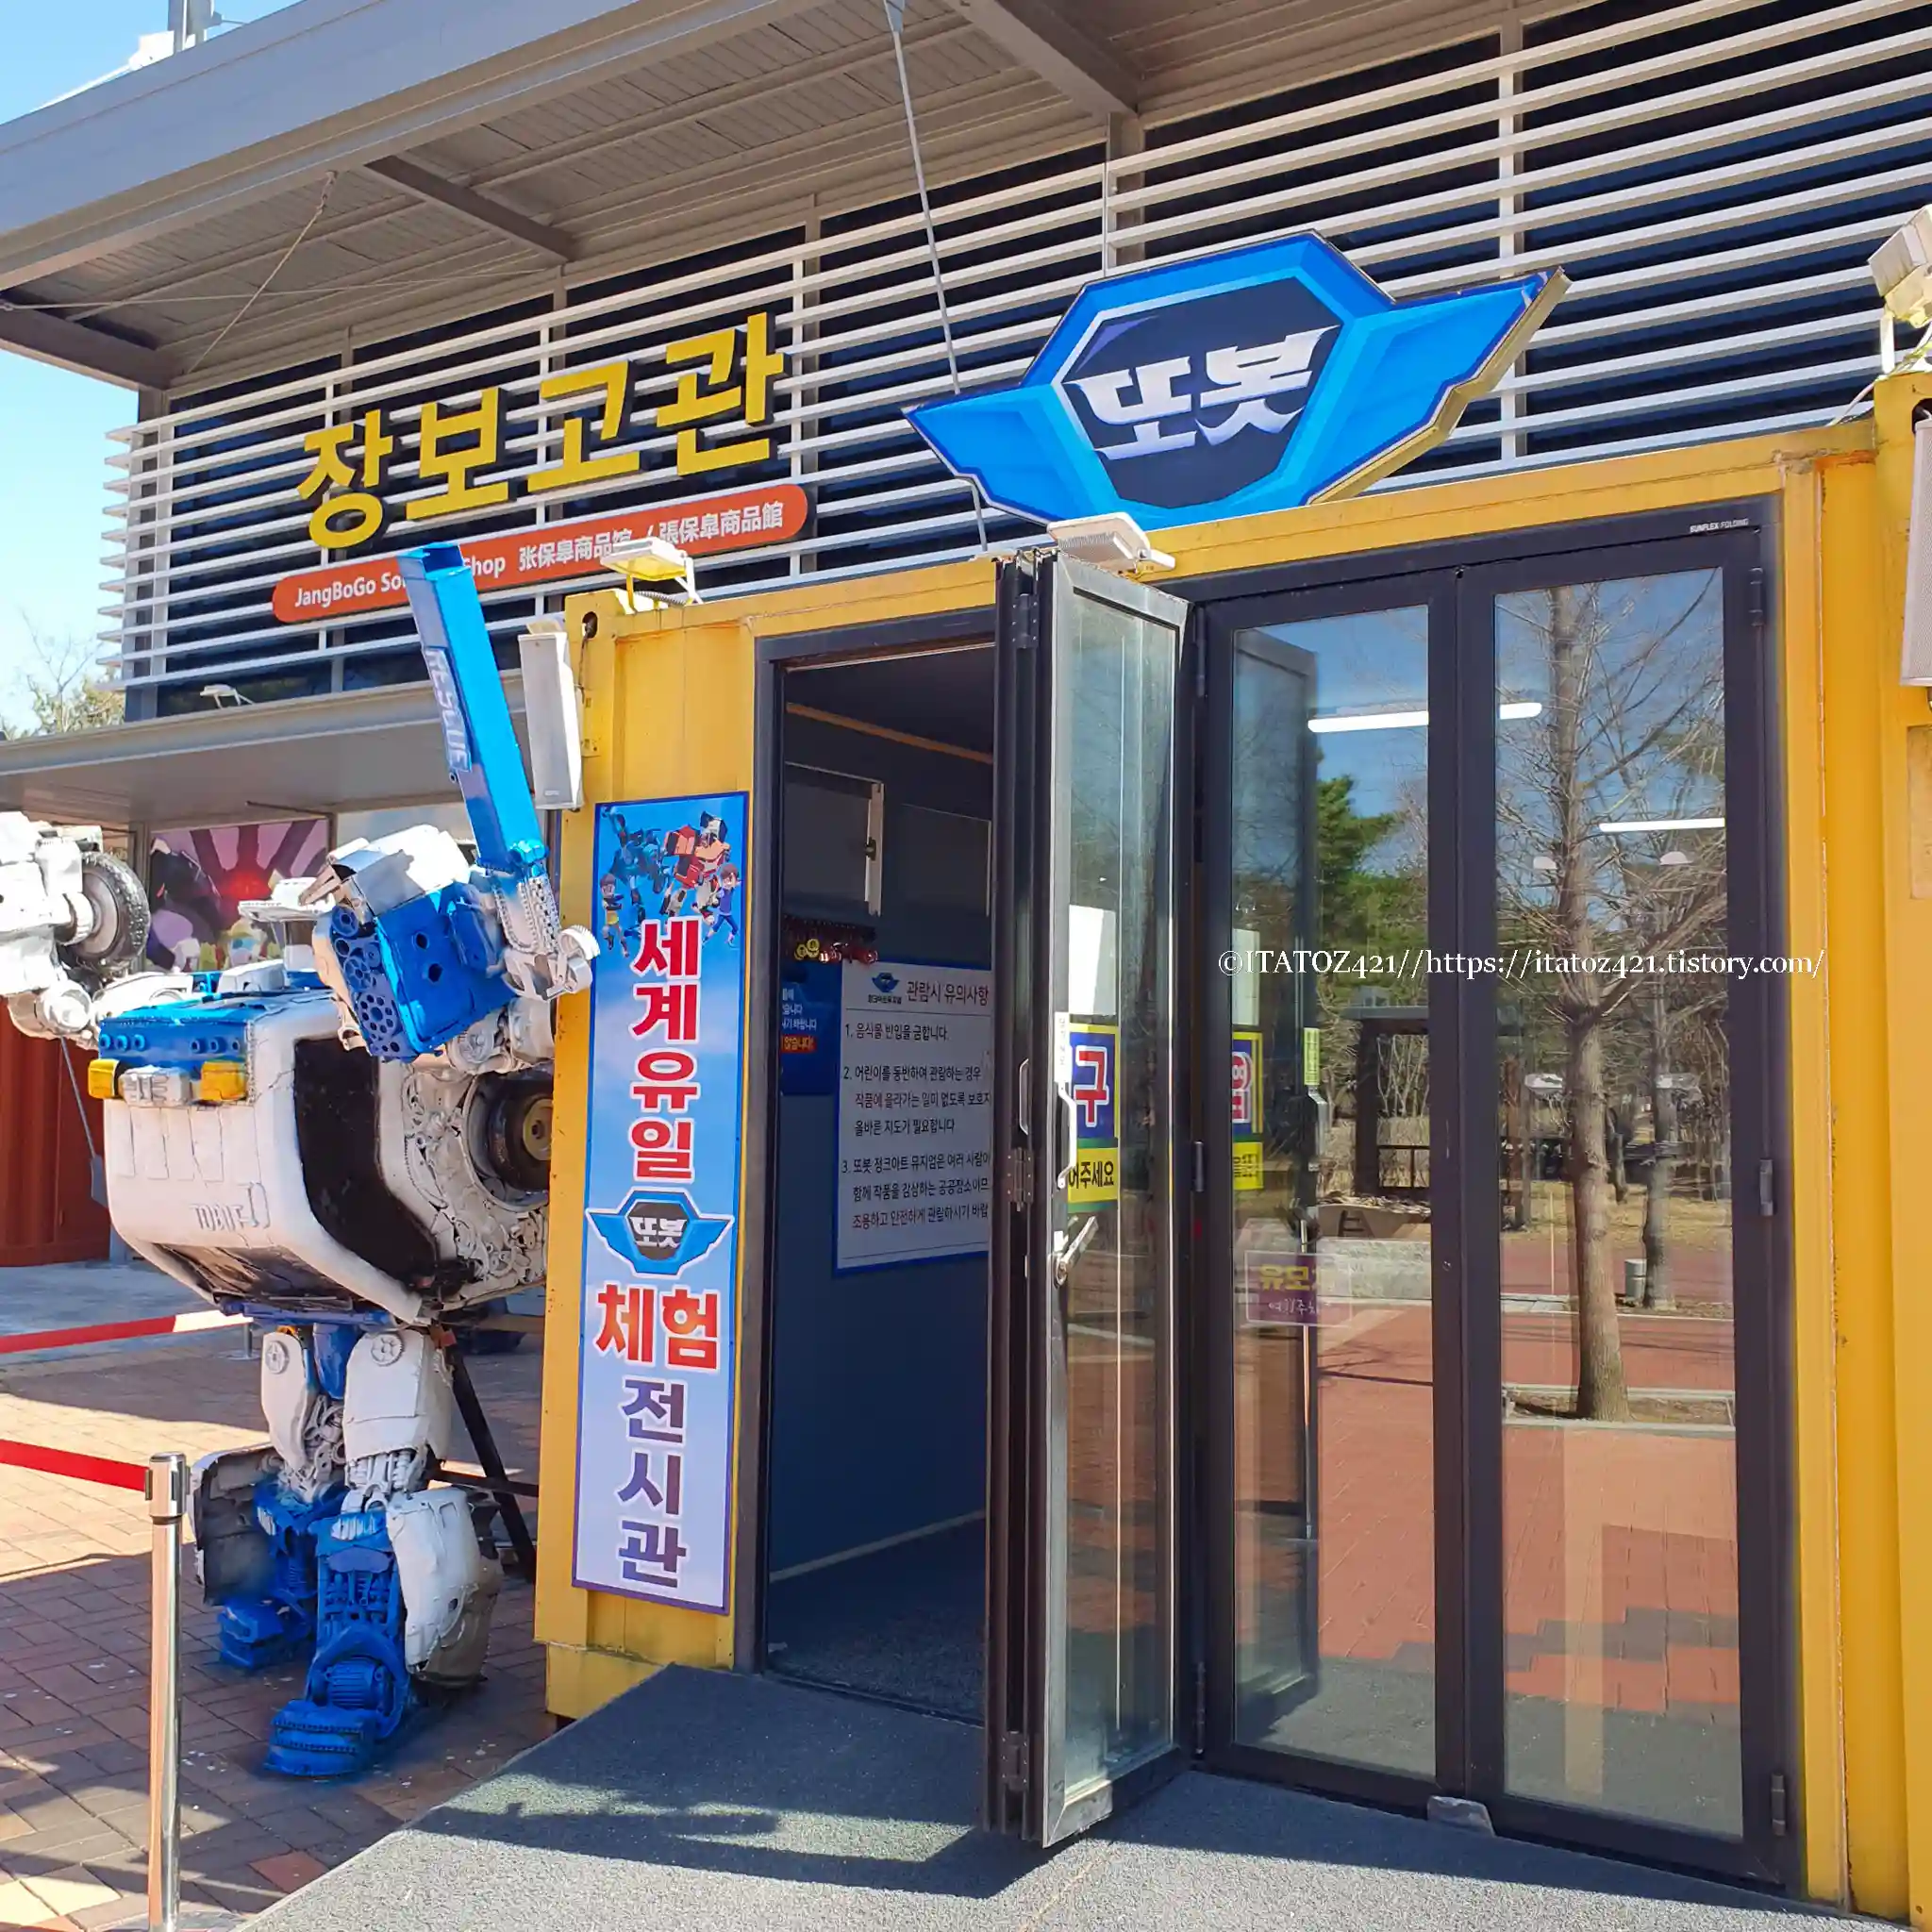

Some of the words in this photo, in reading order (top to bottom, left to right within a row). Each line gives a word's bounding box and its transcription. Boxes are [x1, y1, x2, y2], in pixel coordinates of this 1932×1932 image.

[1061, 325, 1341, 461] 또봇
[296, 311, 787, 548] 장보고관
[294, 575, 376, 608] JangBoGo
[907, 981, 941, 1003] 관람시
[944, 983, 989, 1007] 유의사항
[845, 1024, 853, 1038] 1.
[856, 1023, 883, 1040] 음식물
[630, 918, 702, 1181] 세계유일
[843, 1066, 853, 1080] 2.
[855, 1065, 891, 1082] 어린이를
[892, 1065, 927, 1082] 동반하여
[929, 1065, 963, 1082] 관람하는
[965, 1067, 982, 1082] 경우
[855, 1092, 883, 1109] 작품에
[885, 1091, 920, 1109] 올라가는
[941, 1092, 966, 1108] 없도록
[854, 1120, 882, 1137] 올바른
[884, 1119, 910, 1135] 지도가
[841, 1160, 851, 1174] 3.
[853, 1158, 873, 1174] 또봇
[874, 1156, 909, 1174] 정크아트
[911, 1153, 945, 1172] 뮤지엄은
[947, 1153, 964, 1170] 여러
[853, 1185, 872, 1203] 함께
[874, 1183, 900, 1201] 작품을
[902, 1179, 936, 1198] 감상하는
[852, 1211, 889, 1230] 조용하고
[891, 1208, 925, 1227] 안전하게
[927, 1204, 970, 1224] 관람하시기
[629, 1216, 688, 1249] 또봇
[593, 1282, 721, 1372] 체험
[616, 1378, 688, 1589] 전시관
